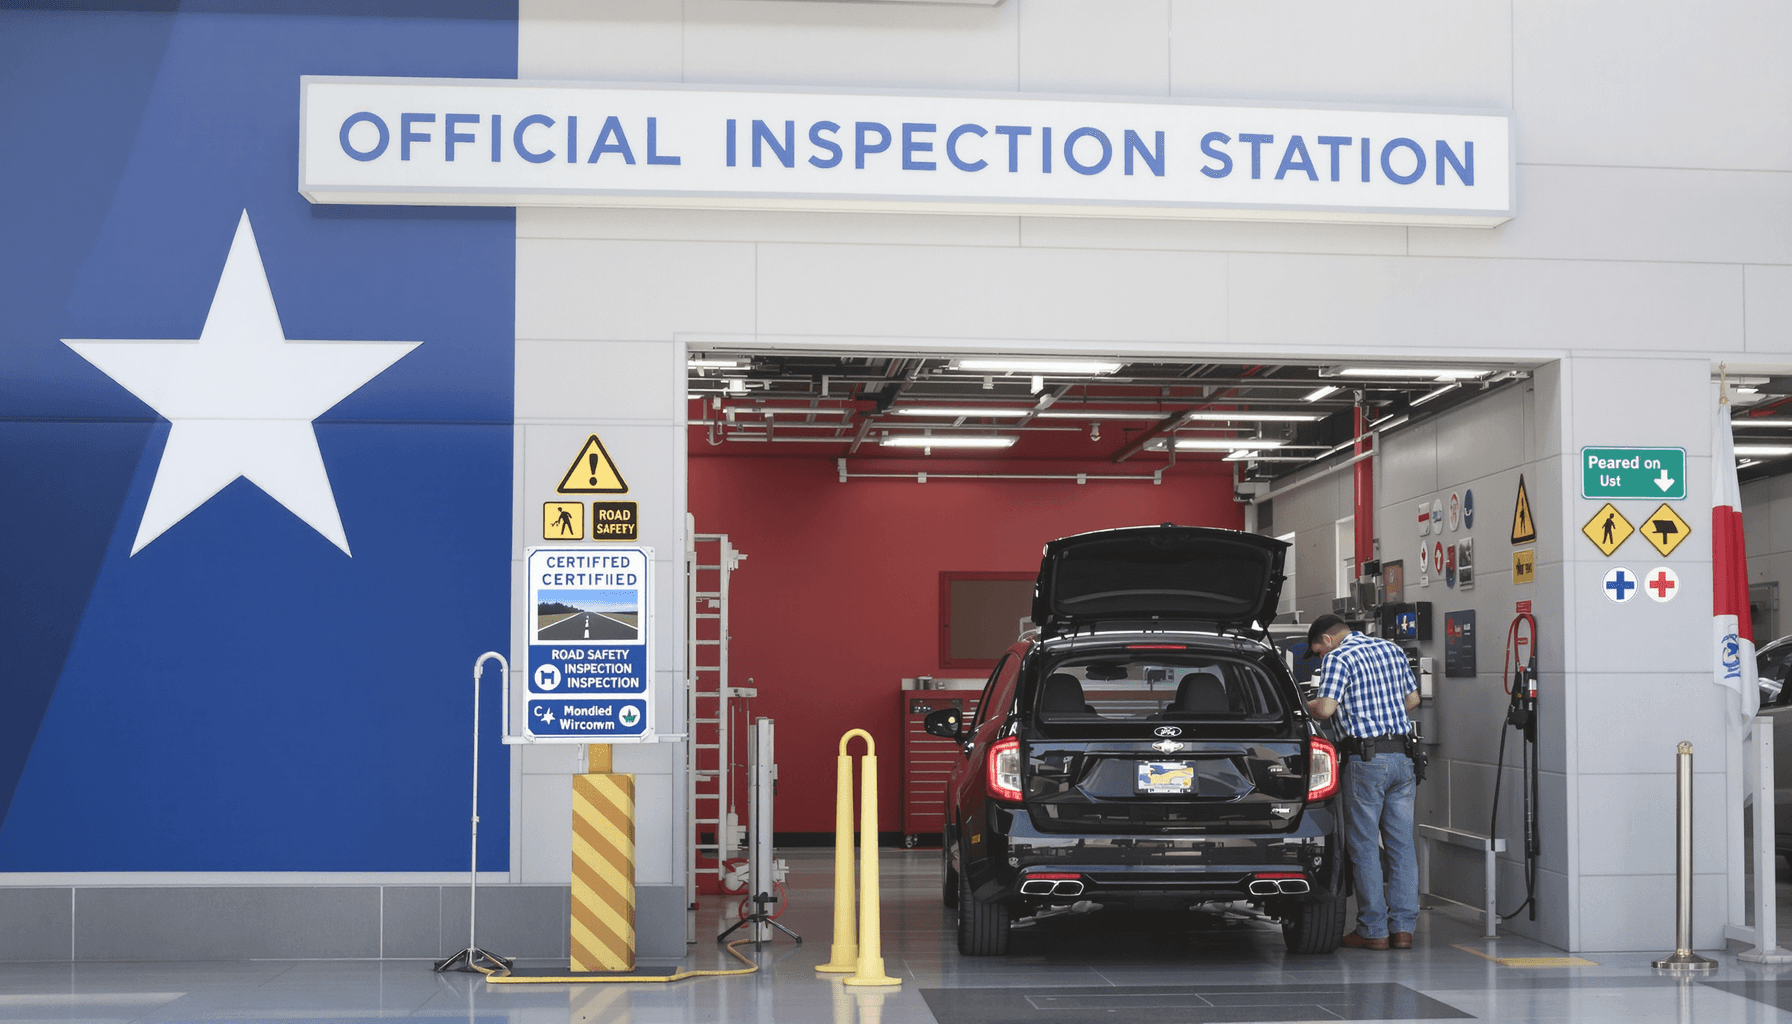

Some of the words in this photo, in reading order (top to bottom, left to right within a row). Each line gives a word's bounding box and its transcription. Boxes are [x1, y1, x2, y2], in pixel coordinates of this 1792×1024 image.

[338, 111, 682, 166] OFFICIAL
[726, 118, 1165, 177] INSPECTION
[1199, 131, 1475, 187] STATION
[1588, 455, 1640, 470] Peared
[1643, 459, 1662, 470] on
[1599, 474, 1622, 488] Ust
[598, 509, 631, 521] ROAD
[551, 649, 585, 660] ROAD
[587, 649, 630, 660] SAFETY
[564, 663, 632, 674] INSPECTION
[567, 677, 639, 688] INSPECTION
